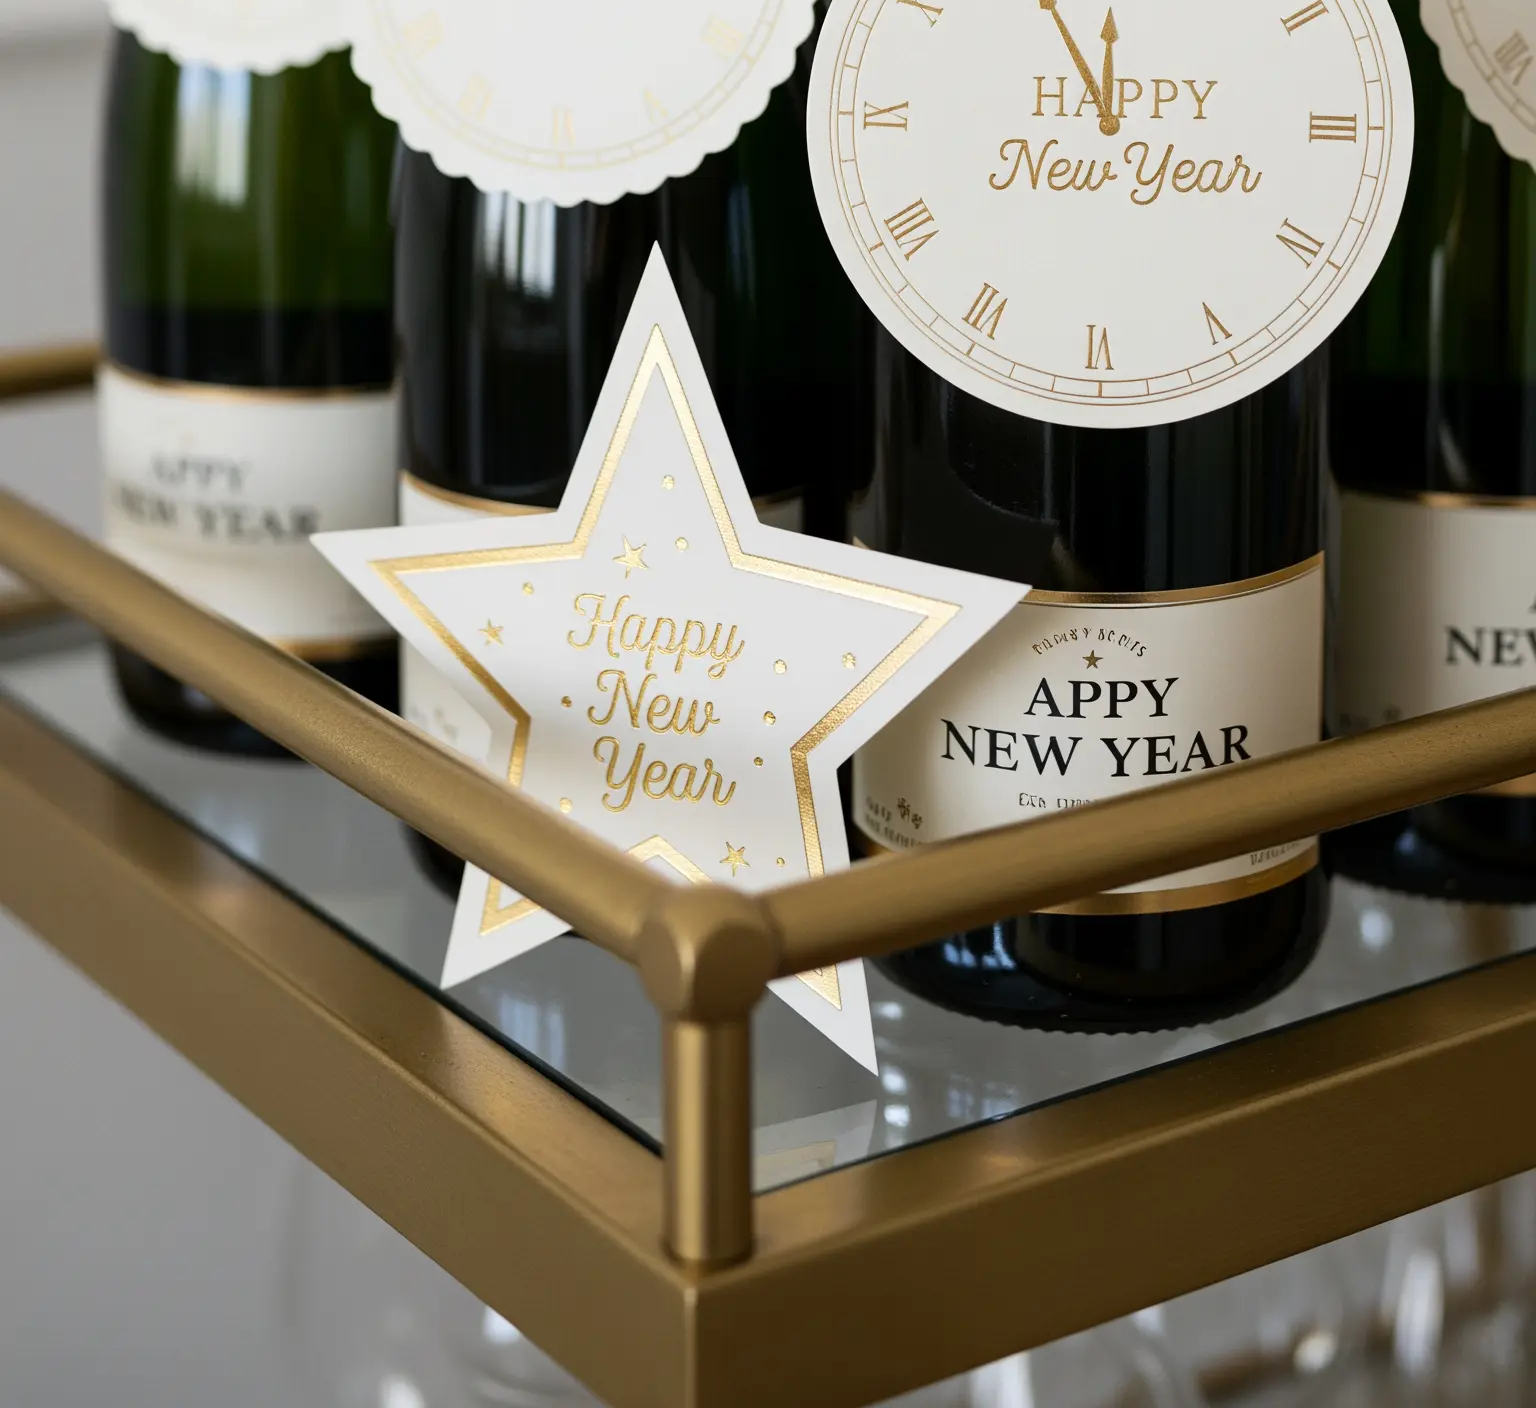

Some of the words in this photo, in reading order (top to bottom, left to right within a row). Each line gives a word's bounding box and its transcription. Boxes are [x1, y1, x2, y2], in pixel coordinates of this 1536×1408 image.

[863, 100, 910, 132] IX
[1031, 75, 1218, 120] HAPPY
[1308, 110, 1358, 144] III
[989, 138, 1119, 192] New
[1123, 141, 1263, 206] Year
[883, 197, 940, 261] VIII
[1275, 217, 1326, 269] IV
[961, 282, 1009, 340] VII
[1202, 301, 1233, 346] V
[1085, 324, 1115, 371] VI
[566, 592, 746, 680] Happy
[1444, 625, 1536, 668] NE
[586, 669, 721, 737] New
[1023, 676, 1180, 720] APPY
[592, 735, 737, 813] Year
[940, 718, 1083, 777] NEW
[1100, 724, 1252, 778] YEAR
